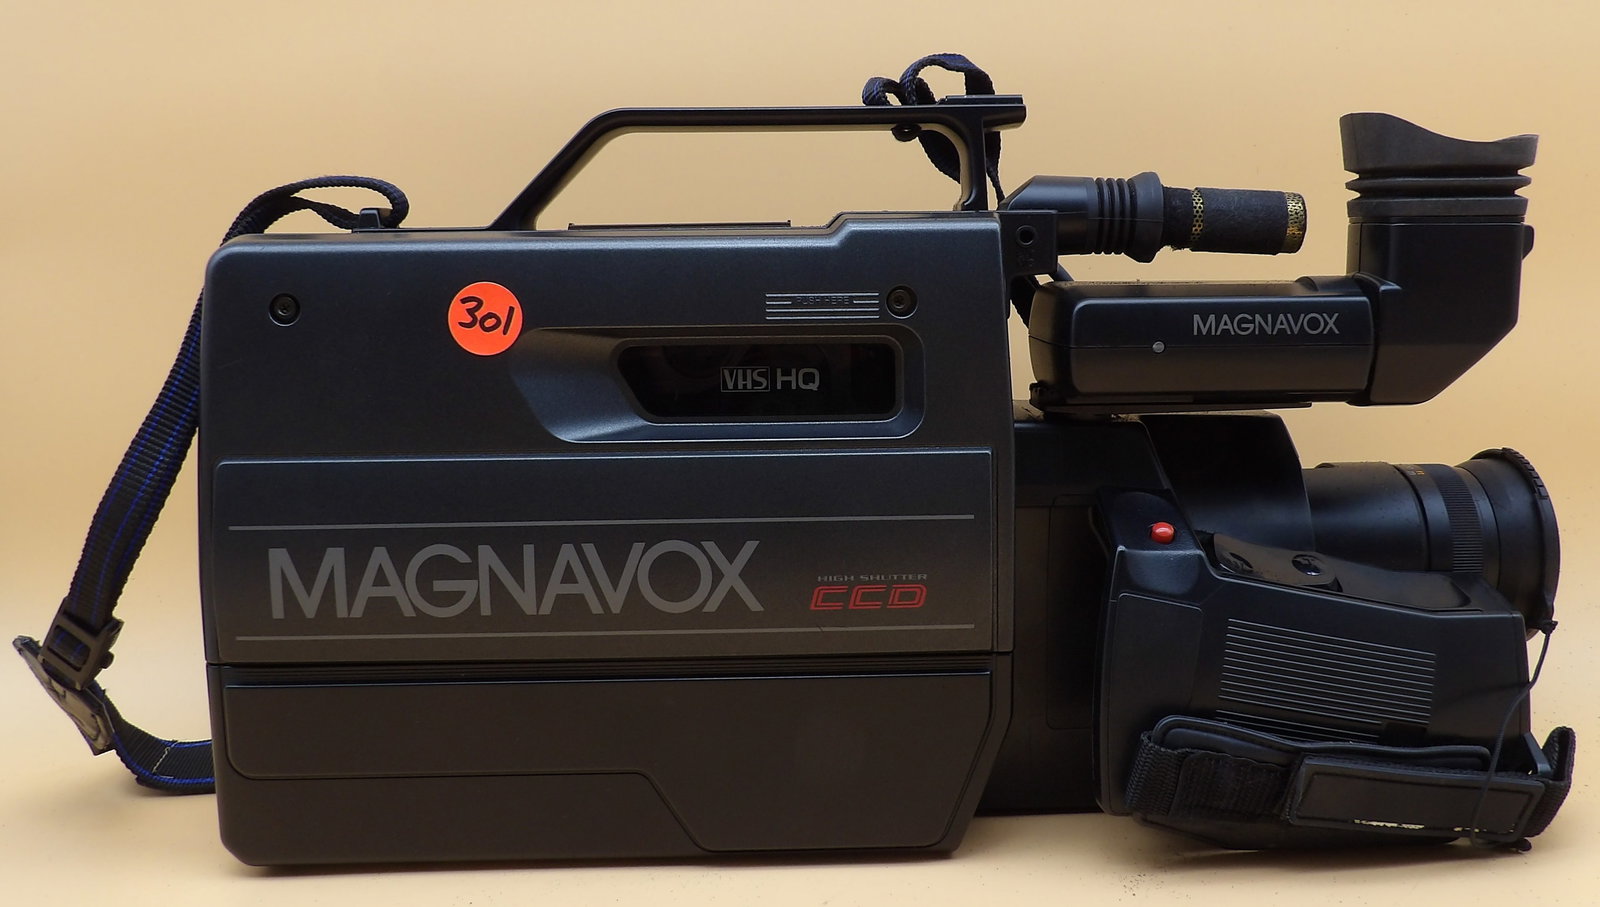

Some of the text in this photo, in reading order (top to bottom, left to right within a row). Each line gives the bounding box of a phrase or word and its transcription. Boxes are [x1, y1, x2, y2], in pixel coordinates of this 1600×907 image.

[458, 296, 515, 336] 301
[1193, 313, 1340, 336] MAGNAVOX
[723, 367, 820, 391] VHS HQ
[268, 540, 765, 619] MAGNAVOX
[817, 573, 928, 582] HIGH SHUTTER
[809, 584, 928, 610] CCD
